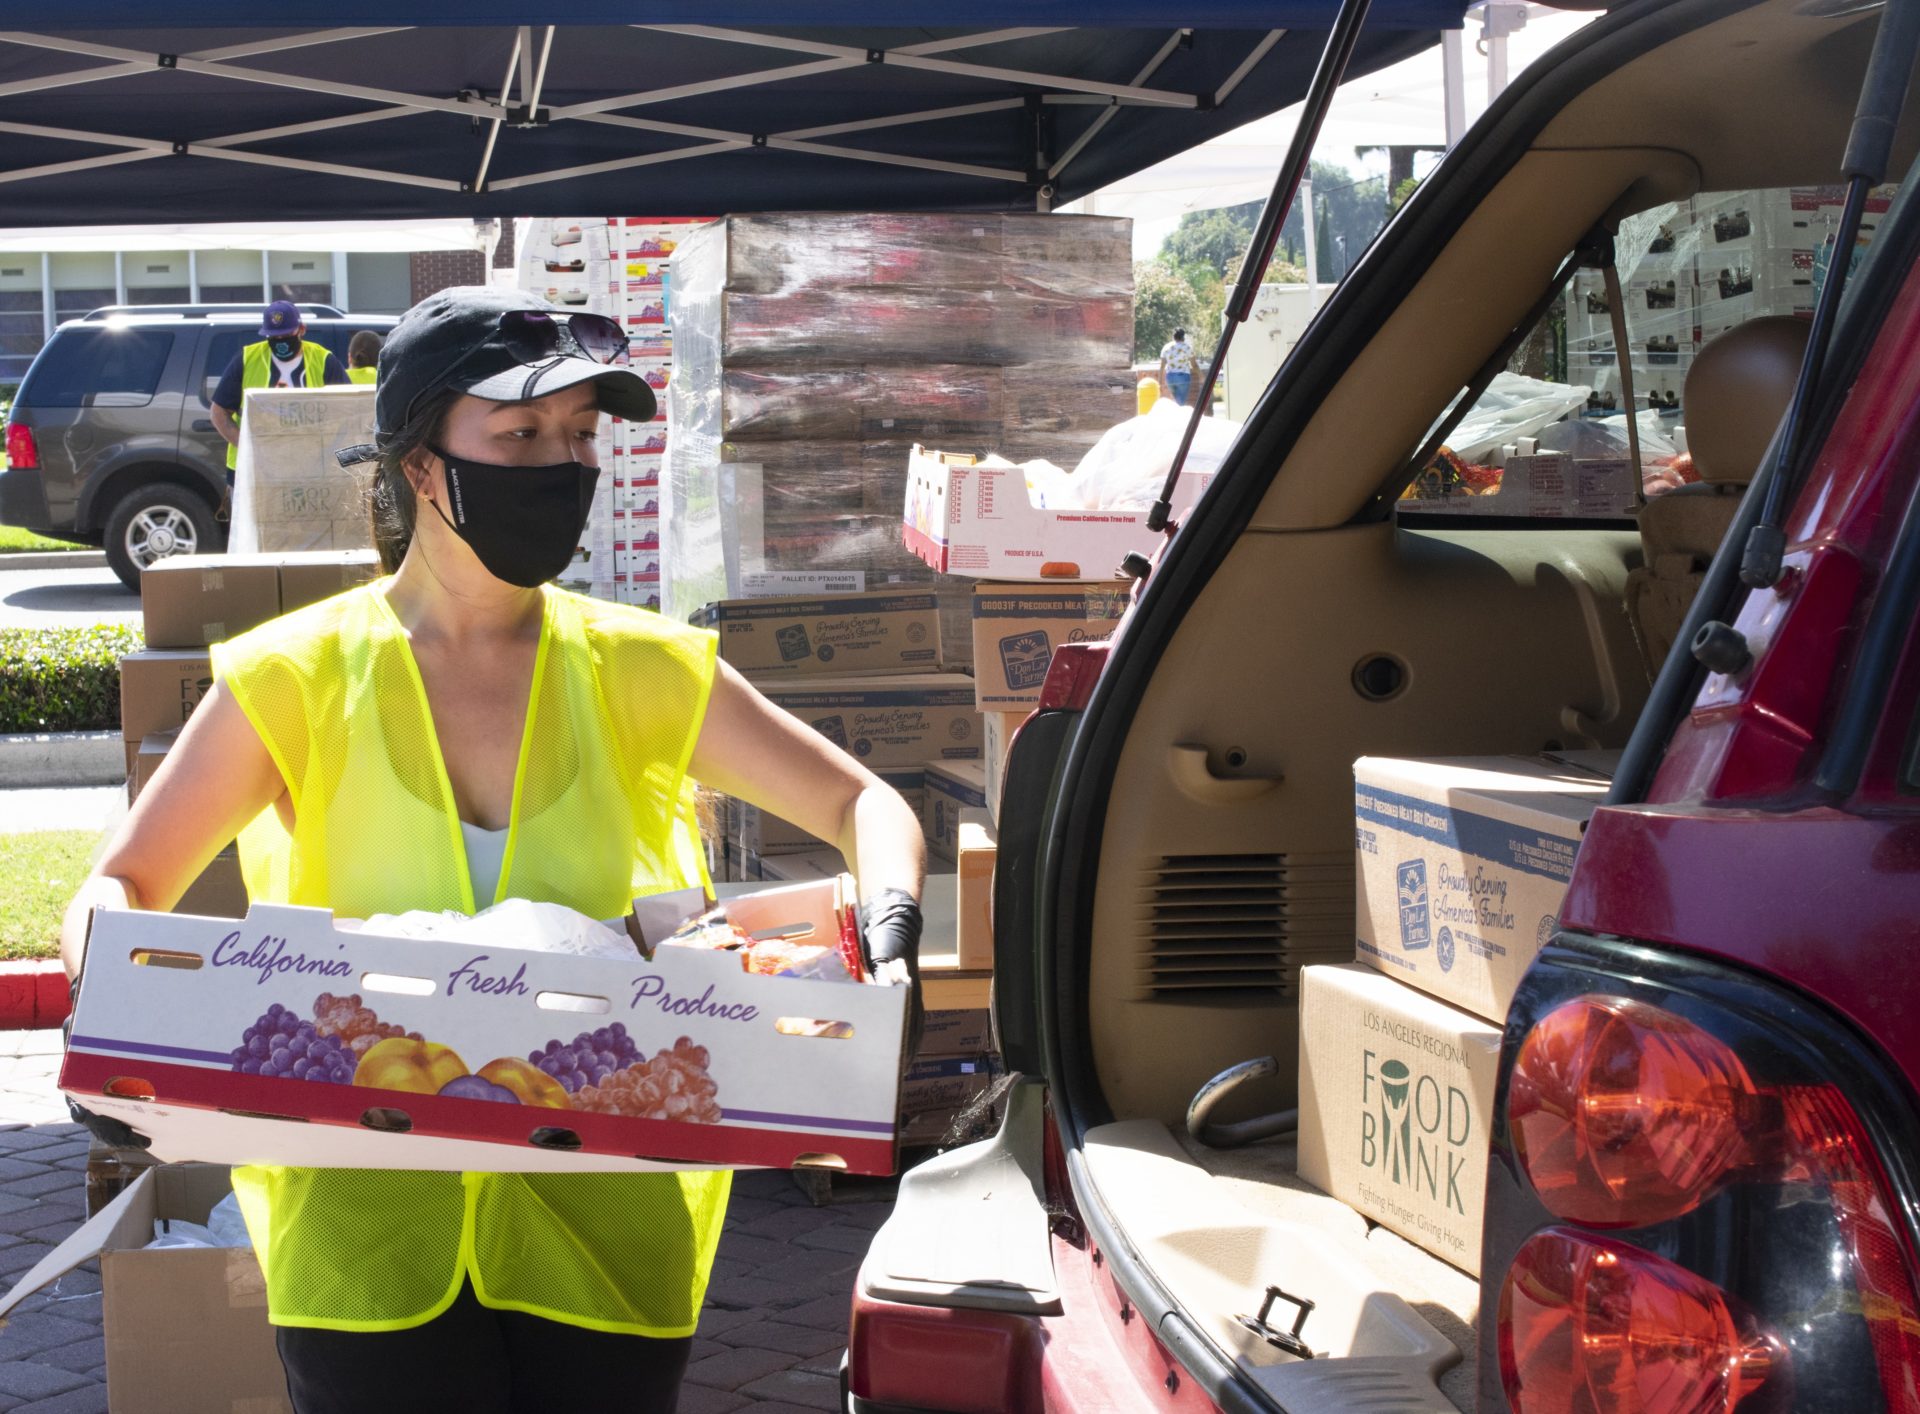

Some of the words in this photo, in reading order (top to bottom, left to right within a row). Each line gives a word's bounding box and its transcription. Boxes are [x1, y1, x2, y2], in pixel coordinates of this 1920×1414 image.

[1083, 515, 1109, 523] California
[1018, 600, 1063, 611] PRECOOKED
[1064, 600, 1086, 610] MEAT
[854, 713, 891, 726] Proudly
[1438, 863, 1474, 899] Proudly
[1473, 865, 1508, 905] Serving
[1433, 894, 1479, 924] America's
[1479, 897, 1515, 930] Families
[211, 931, 353, 985] California
[446, 955, 529, 997] Fresh
[630, 975, 760, 1022] Produce
[1363, 1010, 1381, 1033] LOS
[1382, 1019, 1422, 1049] ANGELES
[1423, 1034, 1471, 1070] REGIONAL
[1363, 1049, 1471, 1147] FOOD
[1358, 1182, 1386, 1214] Fighting
[1417, 1214, 1443, 1244] Giving
[1443, 1228, 1467, 1255] Hope.
